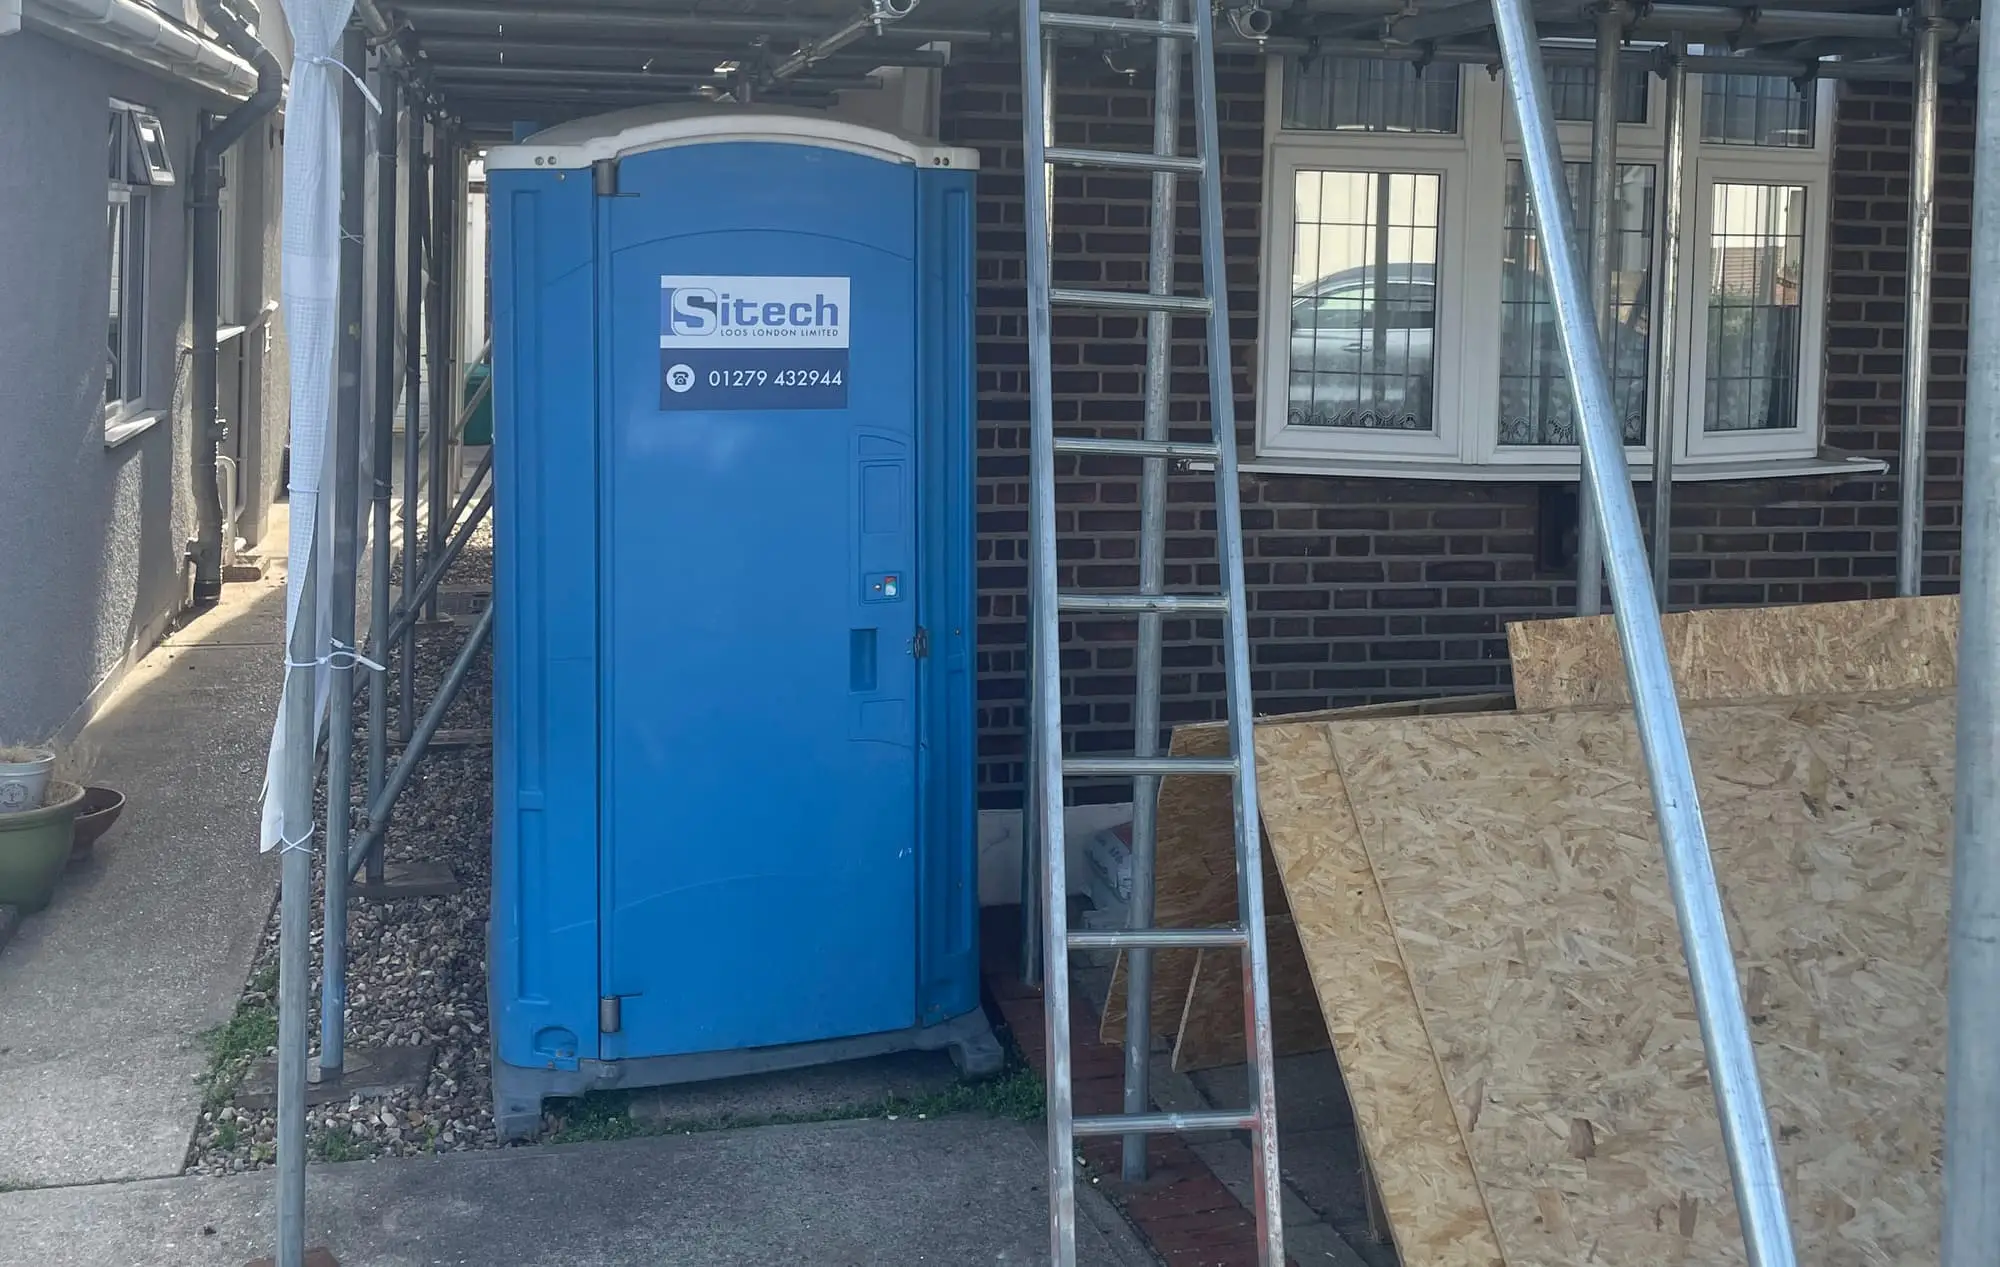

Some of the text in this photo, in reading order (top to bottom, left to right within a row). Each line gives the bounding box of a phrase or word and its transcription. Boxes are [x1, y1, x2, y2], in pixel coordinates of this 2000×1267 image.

[671, 287, 839, 336] Sitech
[720, 328, 839, 337] LOOS LONDON LIMITED
[708, 369, 843, 387] 01279 432944
